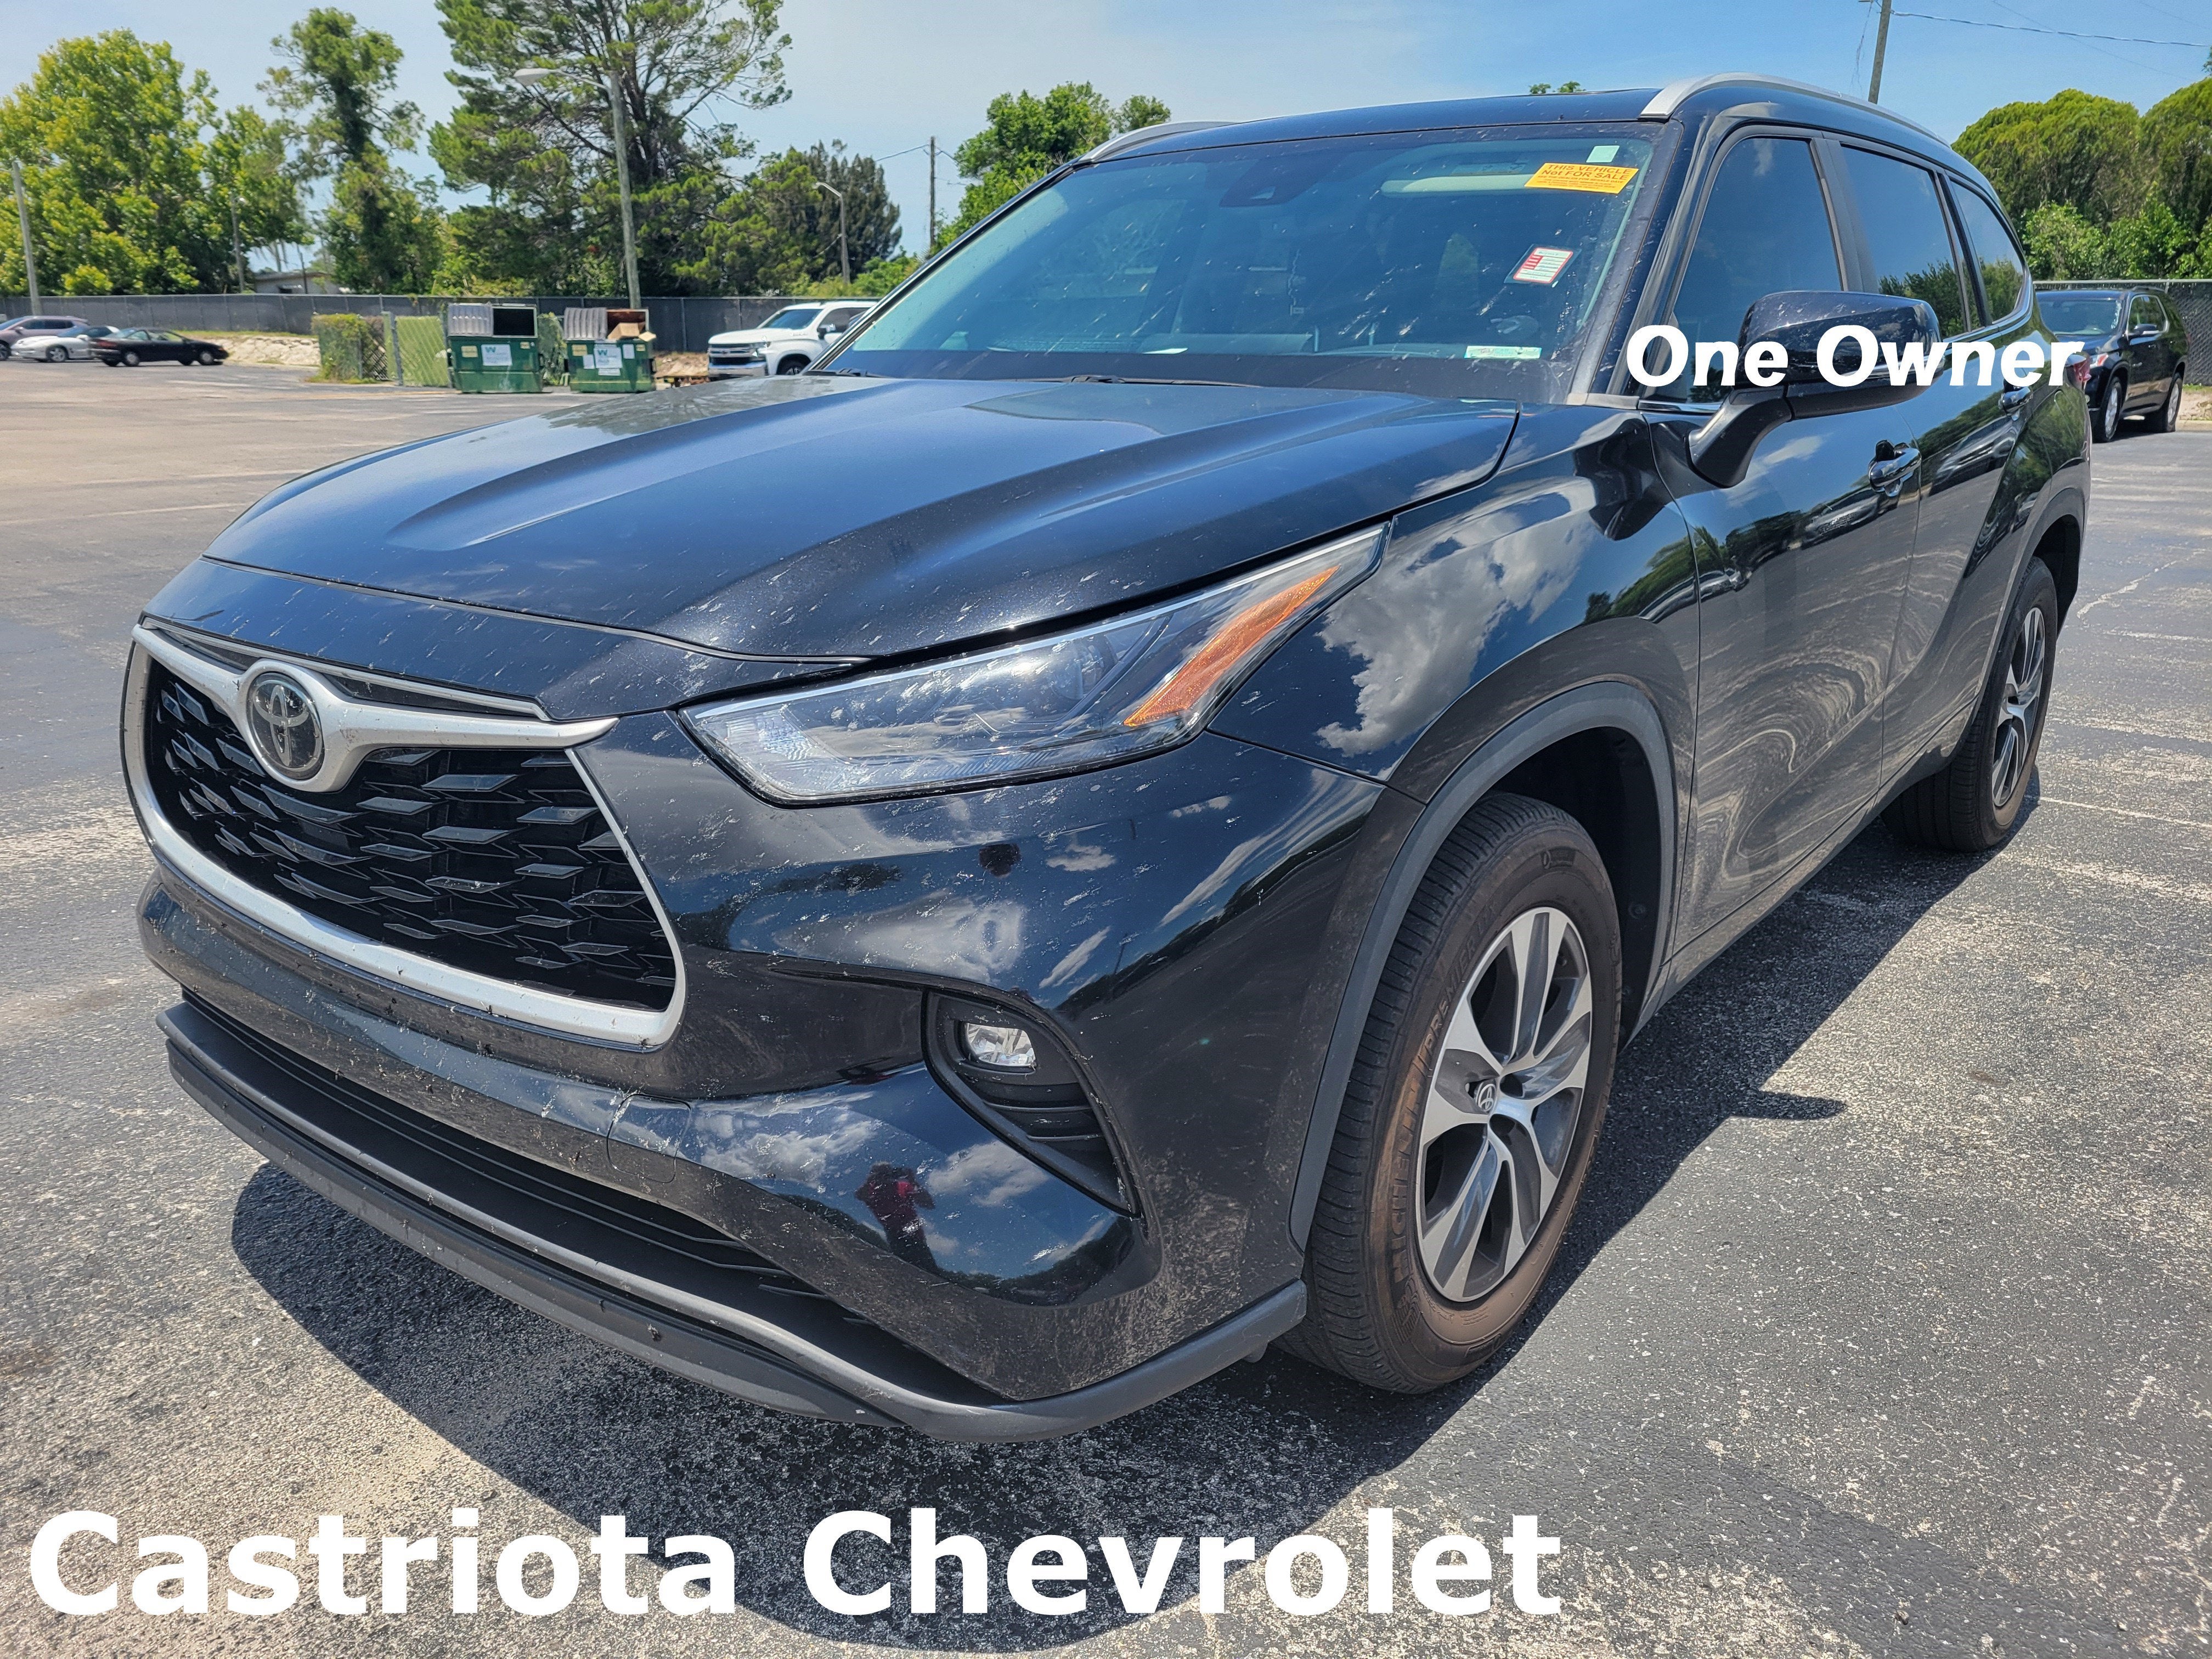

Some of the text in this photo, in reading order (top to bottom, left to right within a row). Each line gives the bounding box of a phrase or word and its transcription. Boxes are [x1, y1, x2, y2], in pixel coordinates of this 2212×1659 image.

[1579, 166, 1633, 174] VEHICLE
[1422, 934, 1477, 1056] PREMIER
[1391, 1080, 1423, 1283] MICHELIN
